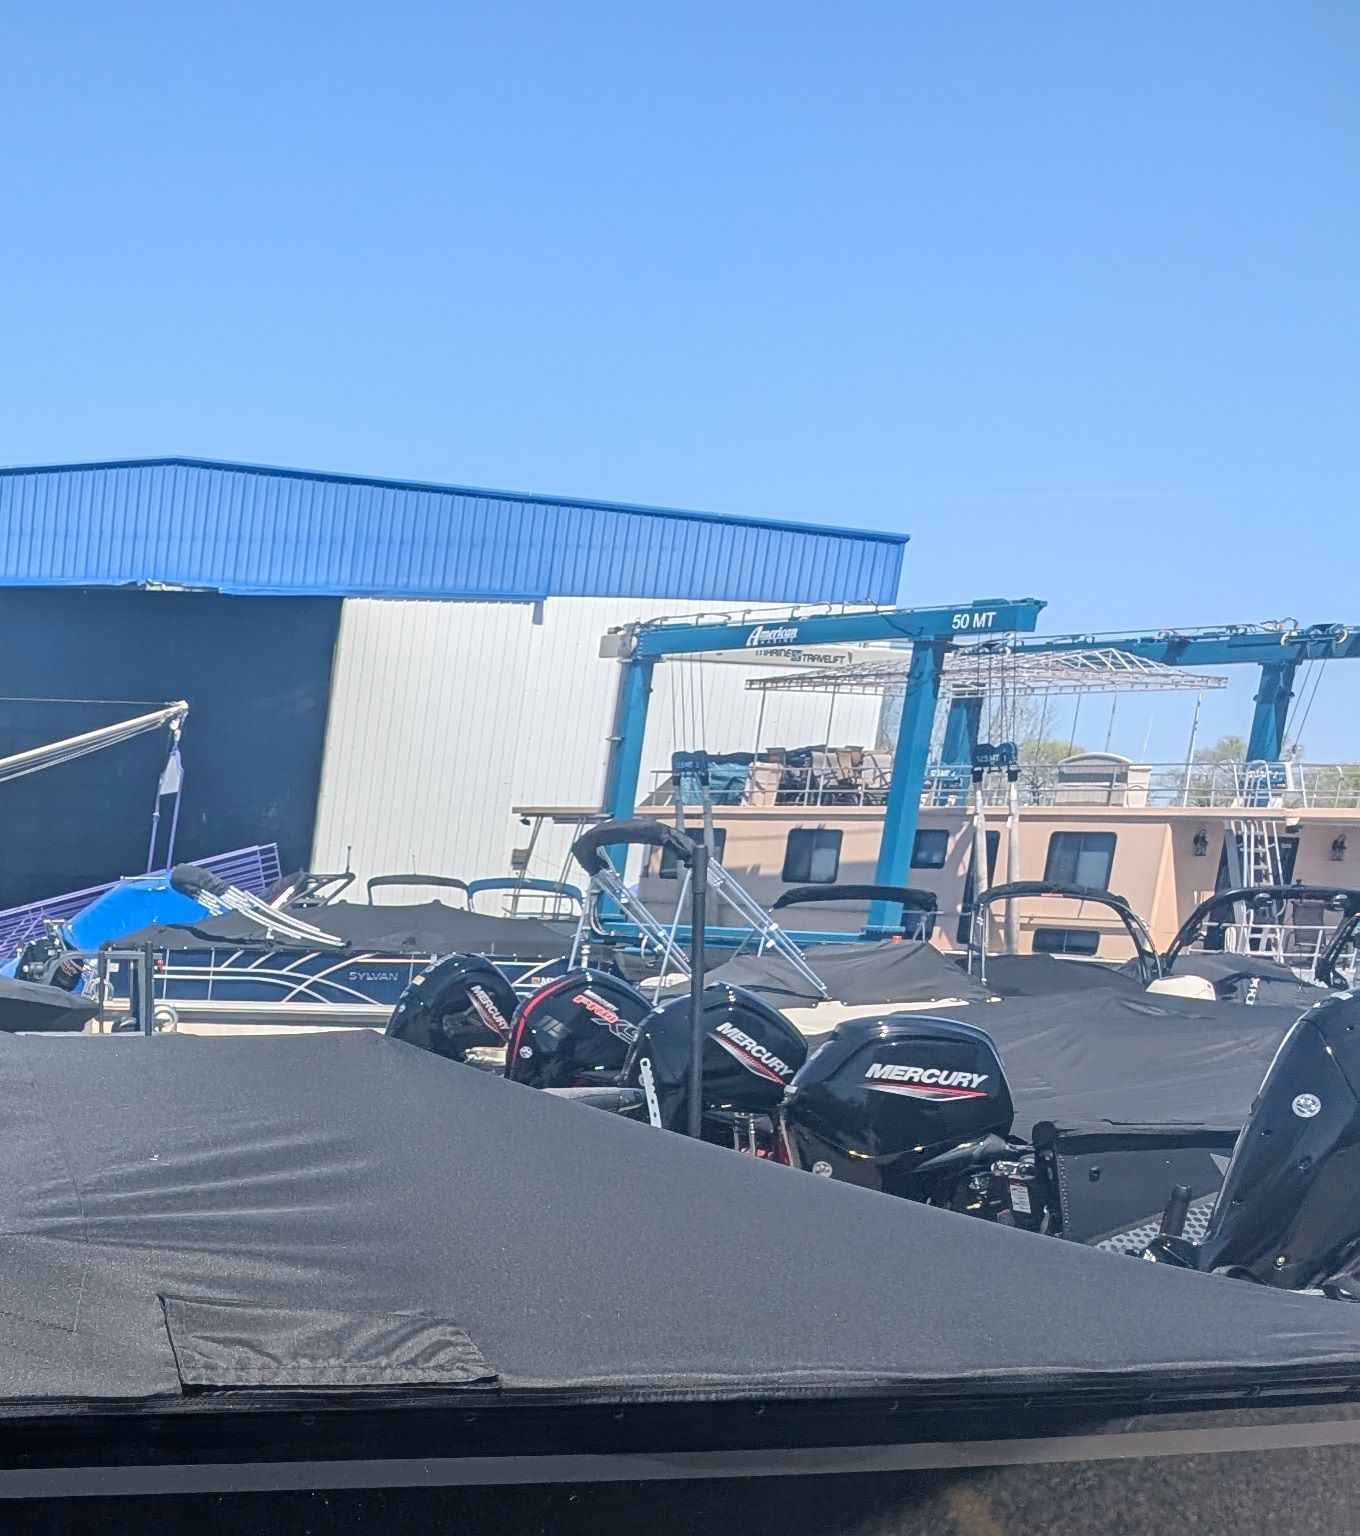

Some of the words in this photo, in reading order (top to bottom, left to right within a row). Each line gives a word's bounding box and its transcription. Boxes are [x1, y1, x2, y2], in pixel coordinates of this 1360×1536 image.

[951, 613, 970, 630] 50
[972, 611, 997, 629] MT
[347, 970, 399, 982] SYLVAN
[471, 984, 511, 1031] MERCURY
[715, 1021, 795, 1076] MERCURY
[864, 1062, 990, 1089] MERCURY
